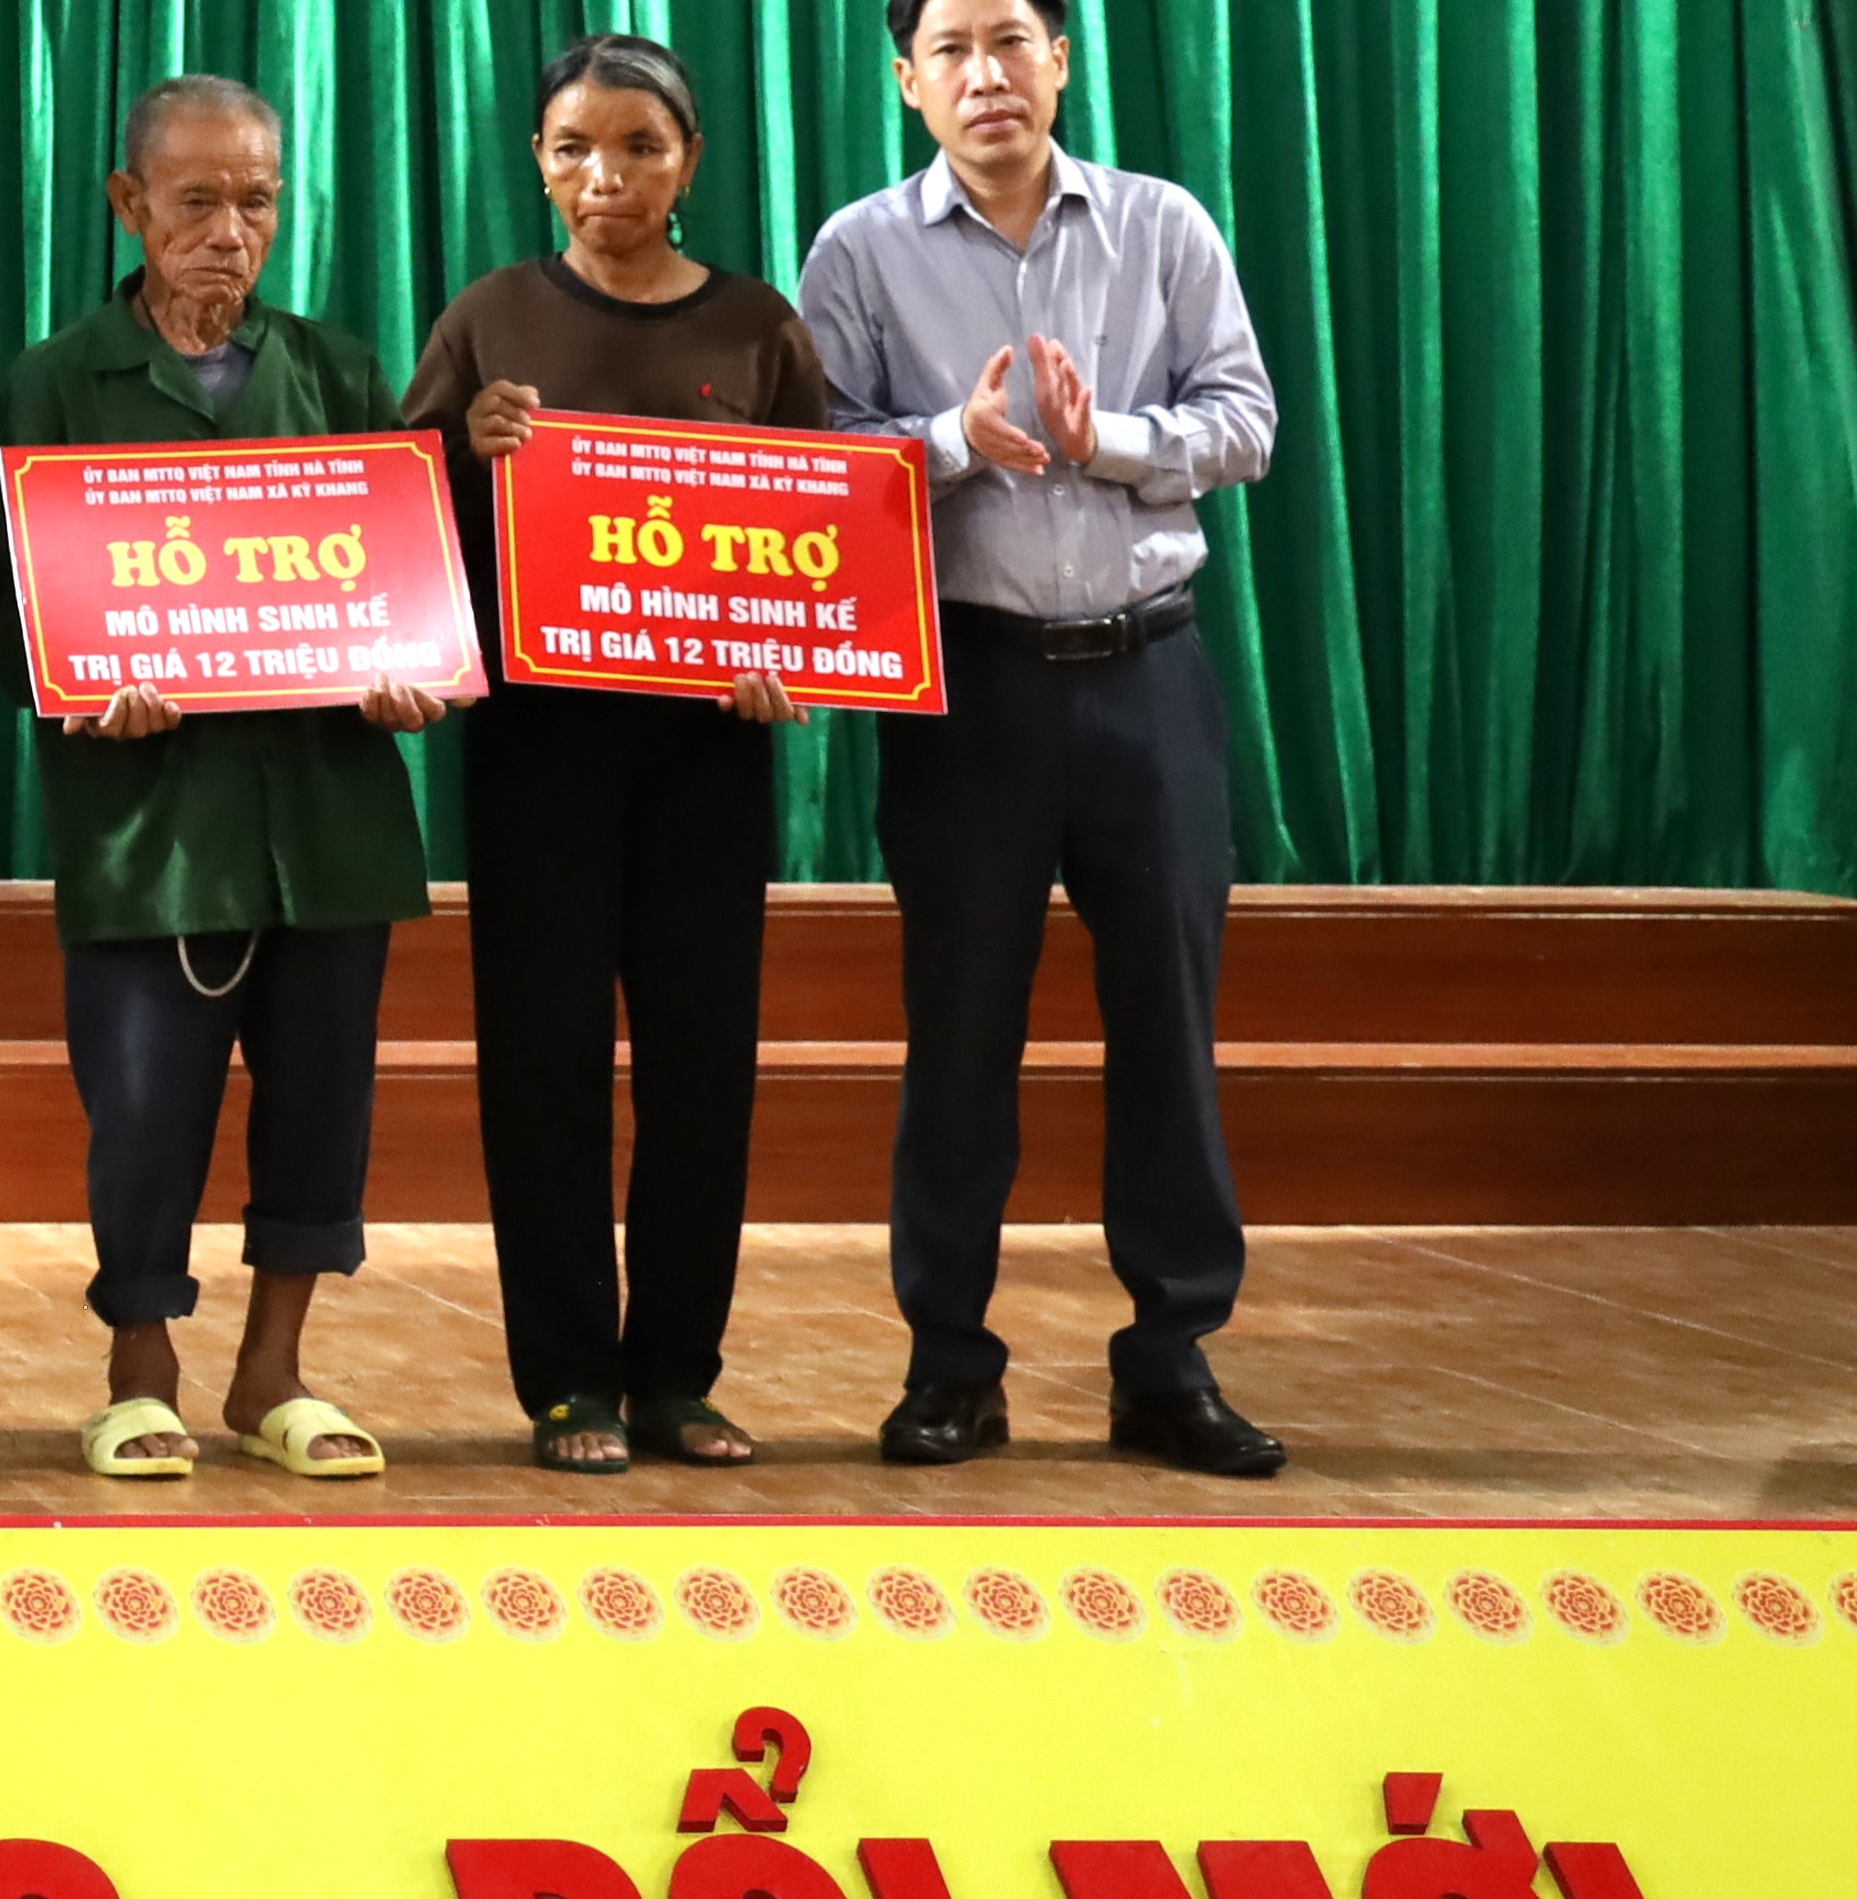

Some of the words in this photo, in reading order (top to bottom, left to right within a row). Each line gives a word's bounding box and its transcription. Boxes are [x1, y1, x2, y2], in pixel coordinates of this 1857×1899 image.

[107, 516, 207, 587] HỖ
[223, 524, 367, 592] TRỢ
[589, 495, 684, 567] HỖ
[701, 524, 839, 591] TRỢ
[105, 605, 159, 636] MÔ
[168, 603, 249, 635] HÌNH
[258, 603, 339, 633] SINH
[346, 592, 391, 628] KẾ
[581, 582, 632, 614] MÔ
[641, 586, 719, 621] HÌNH
[729, 597, 806, 627] SINH
[816, 597, 857, 631] KẾ
[541, 627, 591, 662] TRỊ
[601, 629, 656, 661] GIÁ
[665, 637, 703, 664] 12
[712, 639, 803, 675] TRIỆU
[813, 641, 903, 678] ĐỒNG
